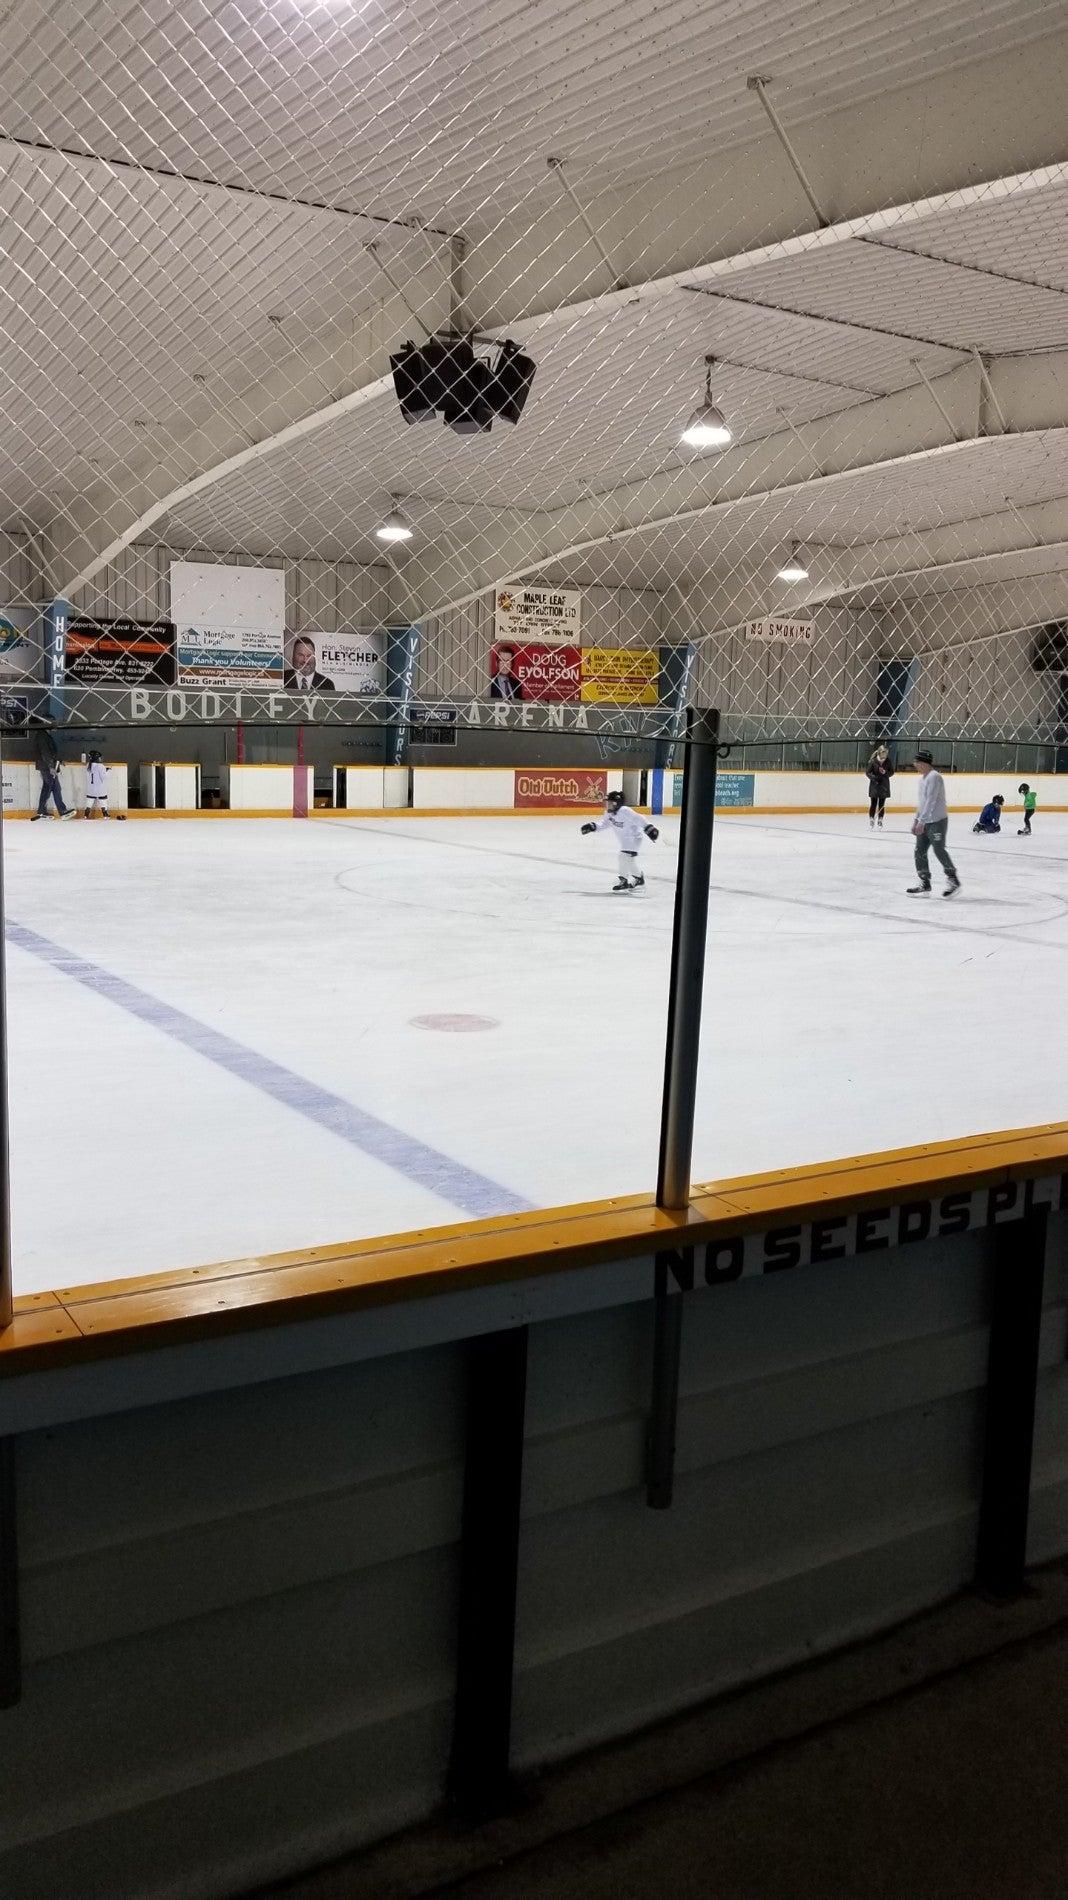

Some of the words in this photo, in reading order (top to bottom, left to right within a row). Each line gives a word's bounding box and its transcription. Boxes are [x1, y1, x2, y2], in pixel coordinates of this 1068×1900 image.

[751, 623, 762, 635] NO
[769, 623, 811, 639] SMOKING
[321, 650, 378, 662] FLETCHER
[533, 654, 566, 666] DOUG
[518, 666, 579, 680] EYOLFSON
[180, 677, 200, 685] Buzz
[202, 678, 226, 686] Grant
[518, 776, 541, 796] Old
[543, 777, 578, 796] Dutch
[654, 1236, 744, 1299] NO
[763, 1194, 972, 1273] SEEDS
